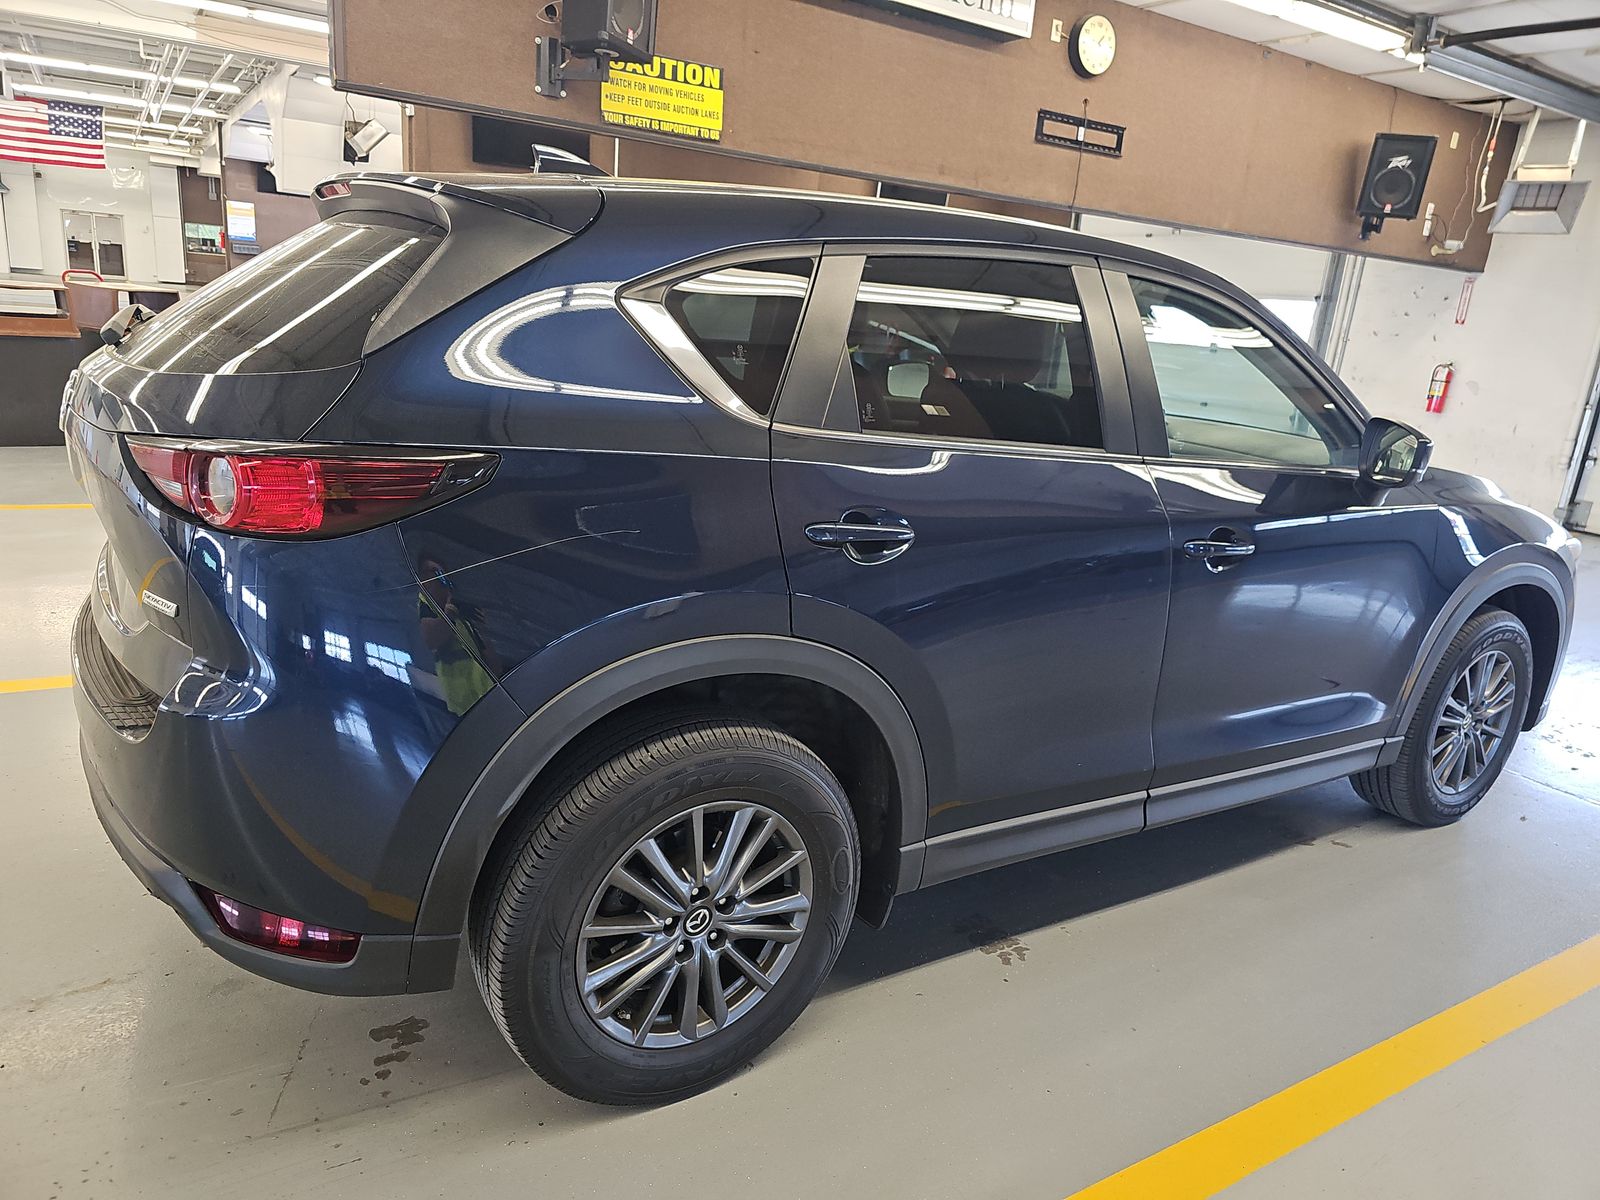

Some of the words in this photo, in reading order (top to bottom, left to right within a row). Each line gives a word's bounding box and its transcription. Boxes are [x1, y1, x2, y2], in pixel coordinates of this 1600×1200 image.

[609, 77, 632, 90] WATCH
[634, 81, 647, 92] FOR
[649, 84, 674, 96] MOVING
[675, 89, 705, 103] VEHICLES
[627, 95, 643, 107] FEET
[644, 98, 671, 112] OUTSIDE
[673, 104, 700, 117] AUCTION
[700, 109, 720, 121] LANES
[603, 111, 623, 124] YOUR
[624, 115, 651, 129] SAFETY
[651, 119, 660, 130] IS
[660, 121, 699, 136] IMPORTANT
[700, 128, 710, 138] TO
[710, 130, 720, 141] US
